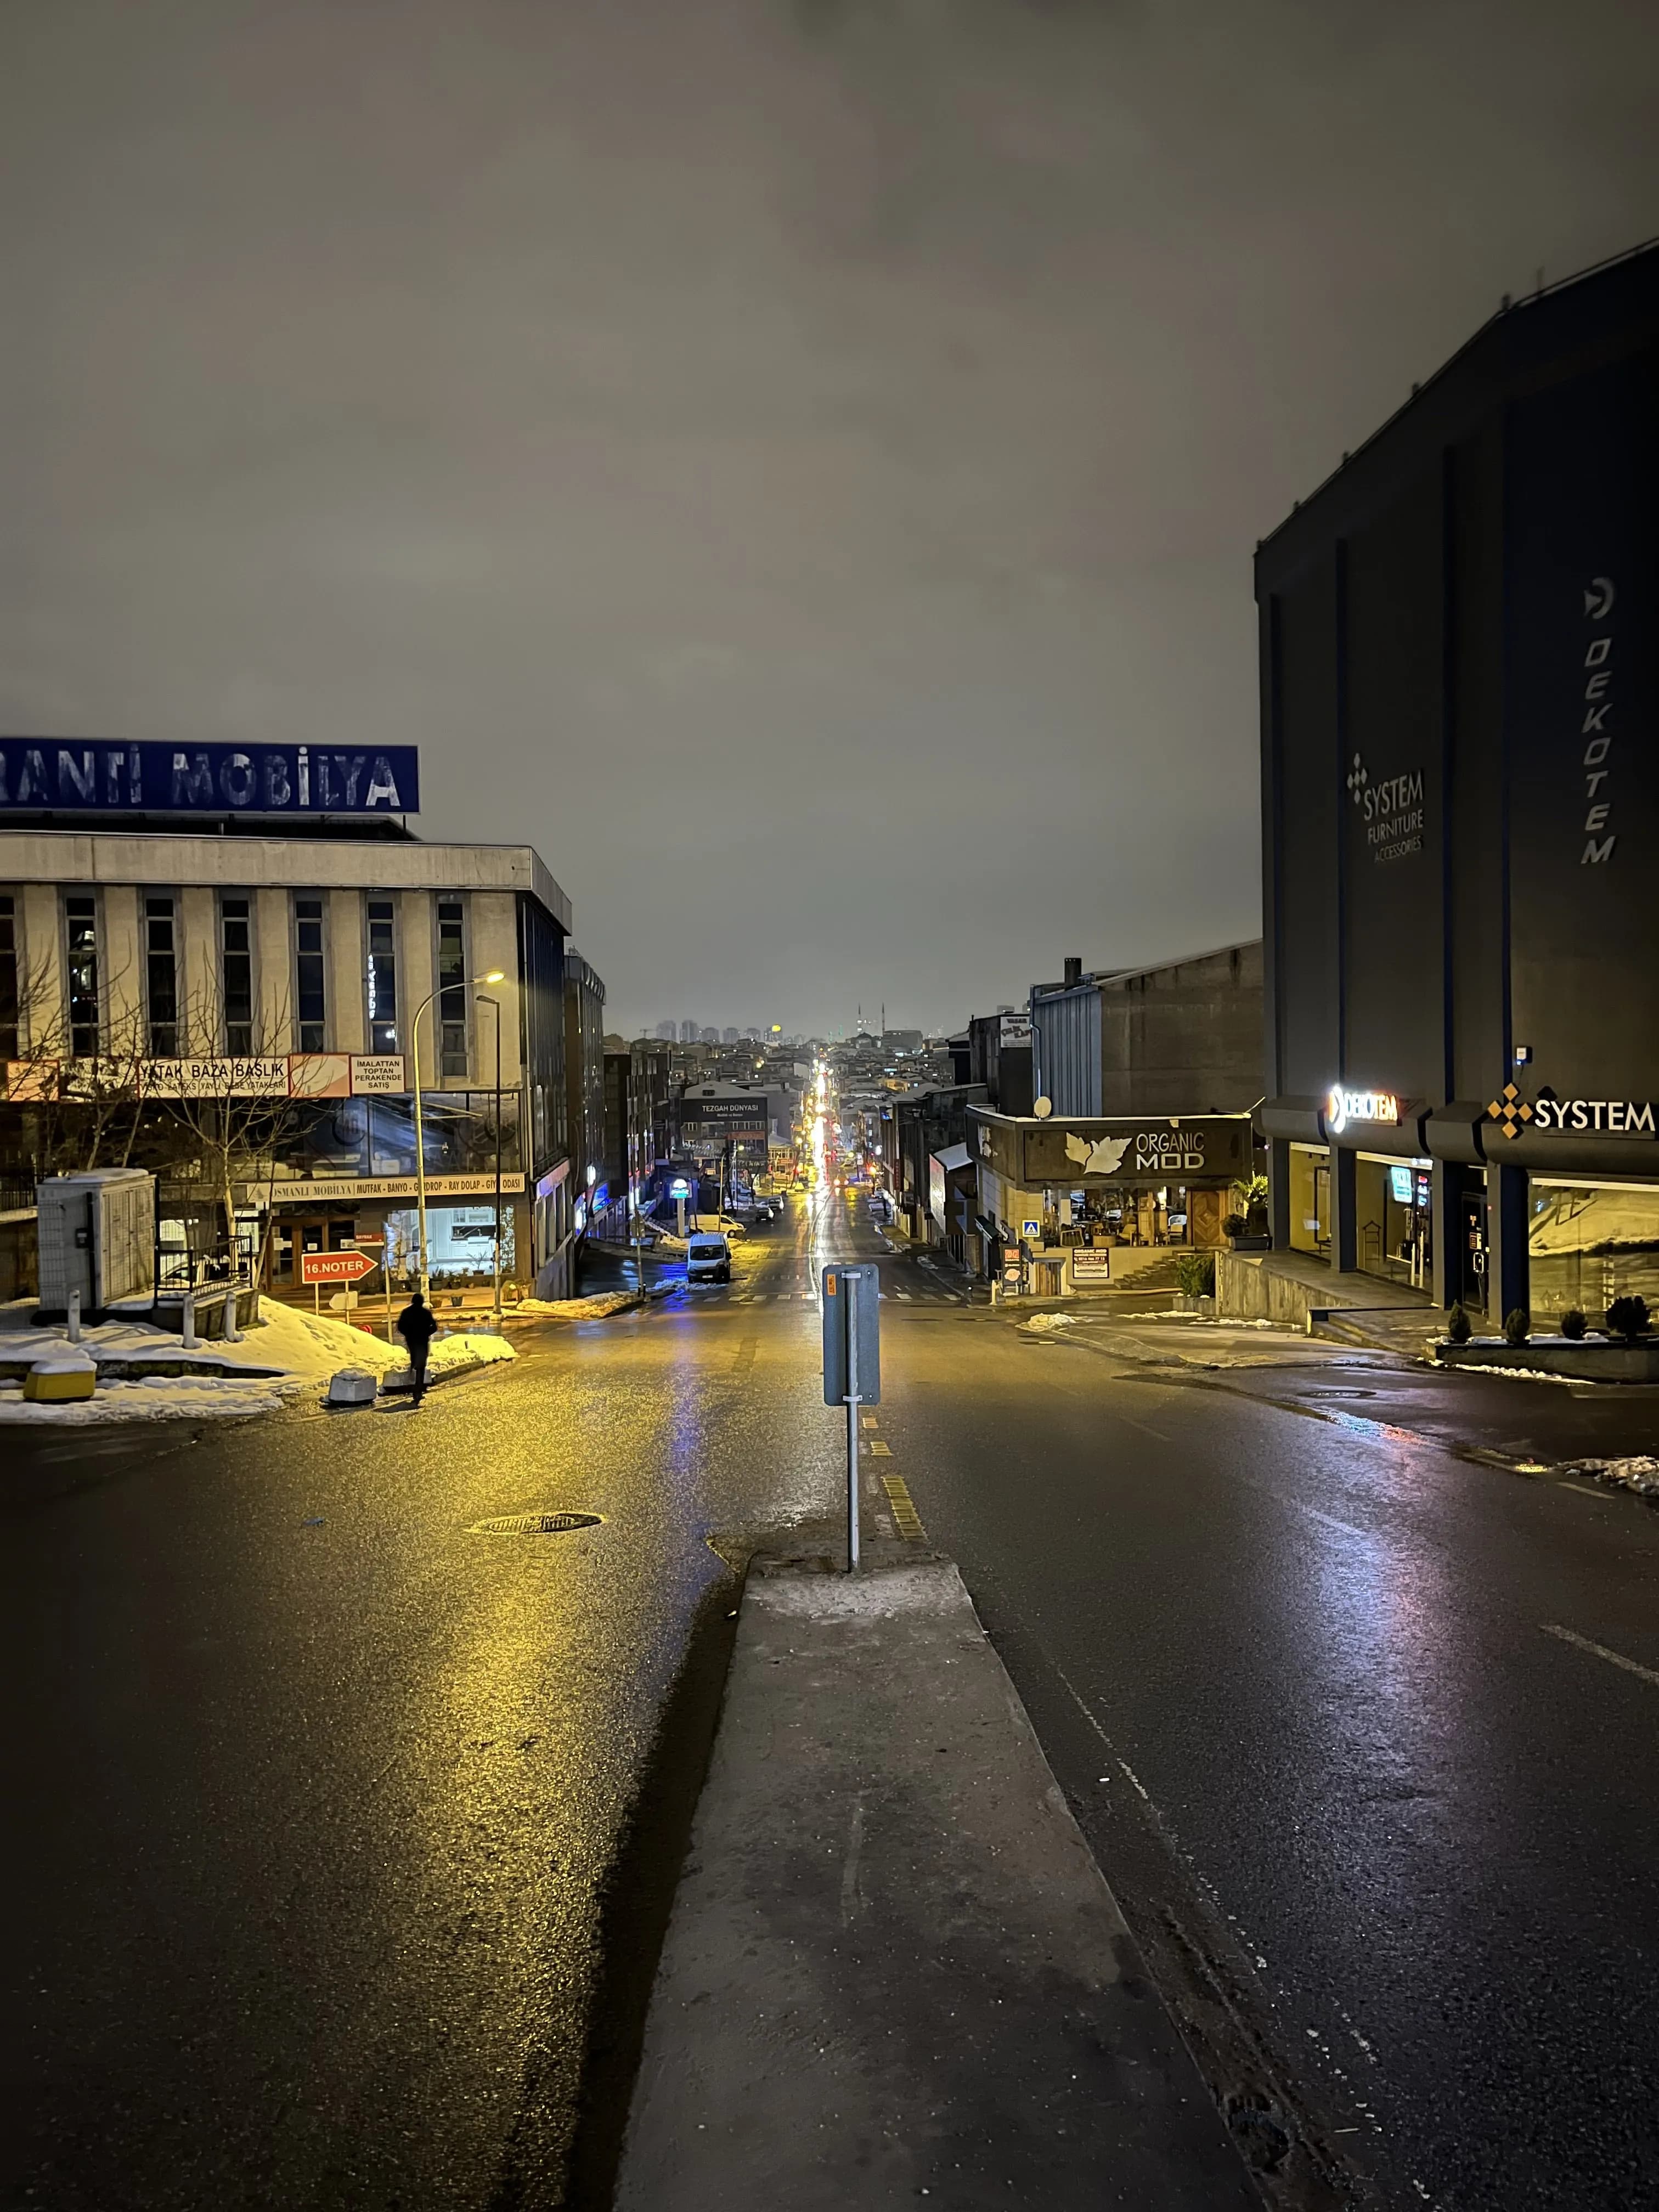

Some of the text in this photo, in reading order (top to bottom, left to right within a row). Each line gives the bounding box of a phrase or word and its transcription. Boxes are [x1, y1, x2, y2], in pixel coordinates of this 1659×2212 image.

[0, 744, 400, 806] ANTİ MOBİLYA
[1364, 769, 1424, 821] SYSTEM
[1368, 809, 1424, 845] FURNITURE
[1374, 835, 1422, 864] ACCESSORIES
[192, 1064, 228, 1078] BAZA
[236, 1063, 284, 1080] BAŞLIK
[1534, 1099, 1656, 1132] SYSTEM
[1136, 1132, 1205, 1152] ORGANIC
[1136, 1153, 1205, 1170] MOD
[313, 1183, 351, 1195] MOBİLYA
[357, 1183, 381, 1194] MUTFAK
[387, 1182, 408, 1193] BANYO
[414, 1181, 443, 1192] GRDROP
[449, 1181, 459, 1190] RAY
[461, 1180, 481, 1190] DOLAP
[503, 1179, 520, 1189] ODASI
[305, 1261, 364, 1274] 16.NOTER
